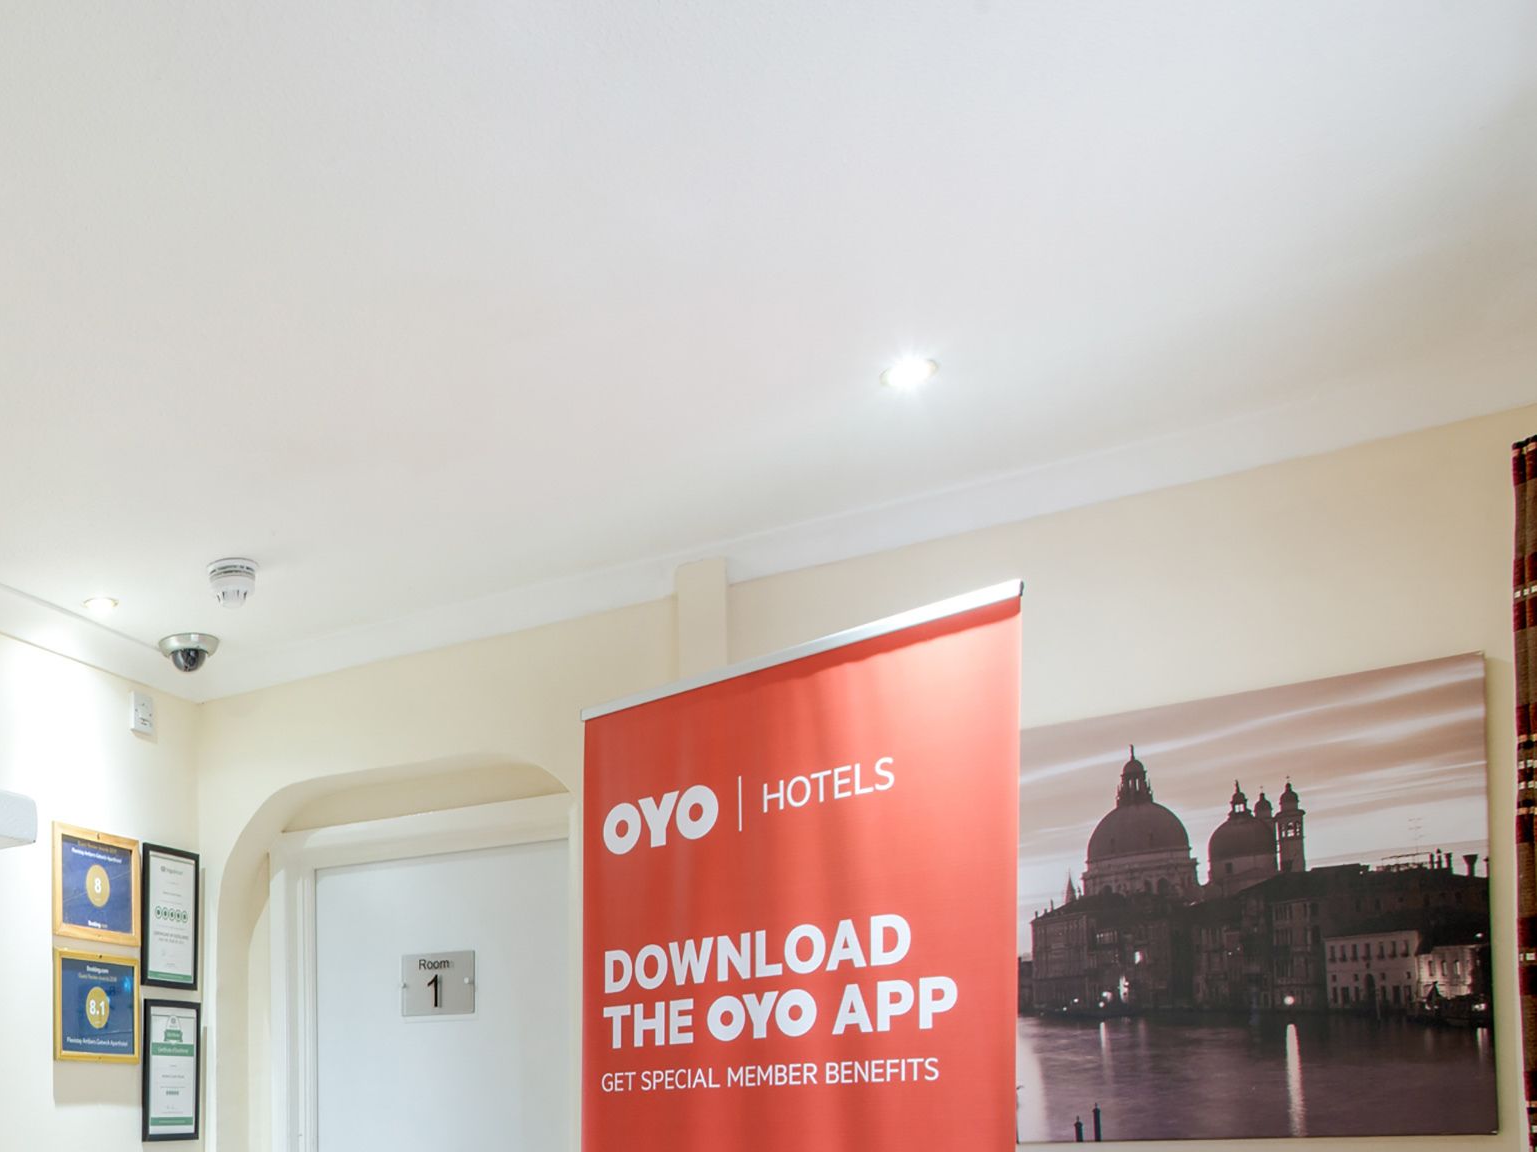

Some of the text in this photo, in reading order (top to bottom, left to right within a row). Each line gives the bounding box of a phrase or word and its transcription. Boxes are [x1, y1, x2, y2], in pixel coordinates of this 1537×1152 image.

[603, 757, 895, 855] OYO HOTELS
[94, 878, 102, 893] 8
[418, 959, 450, 970] Room
[603, 914, 912, 994] DOWNLOAD
[89, 999, 105, 1016] 8.1
[427, 974, 438, 1007] 1
[603, 976, 959, 1049] THE OYO APP
[601, 1056, 940, 1092] GET SPECIAL MEMBER BENEFITS
